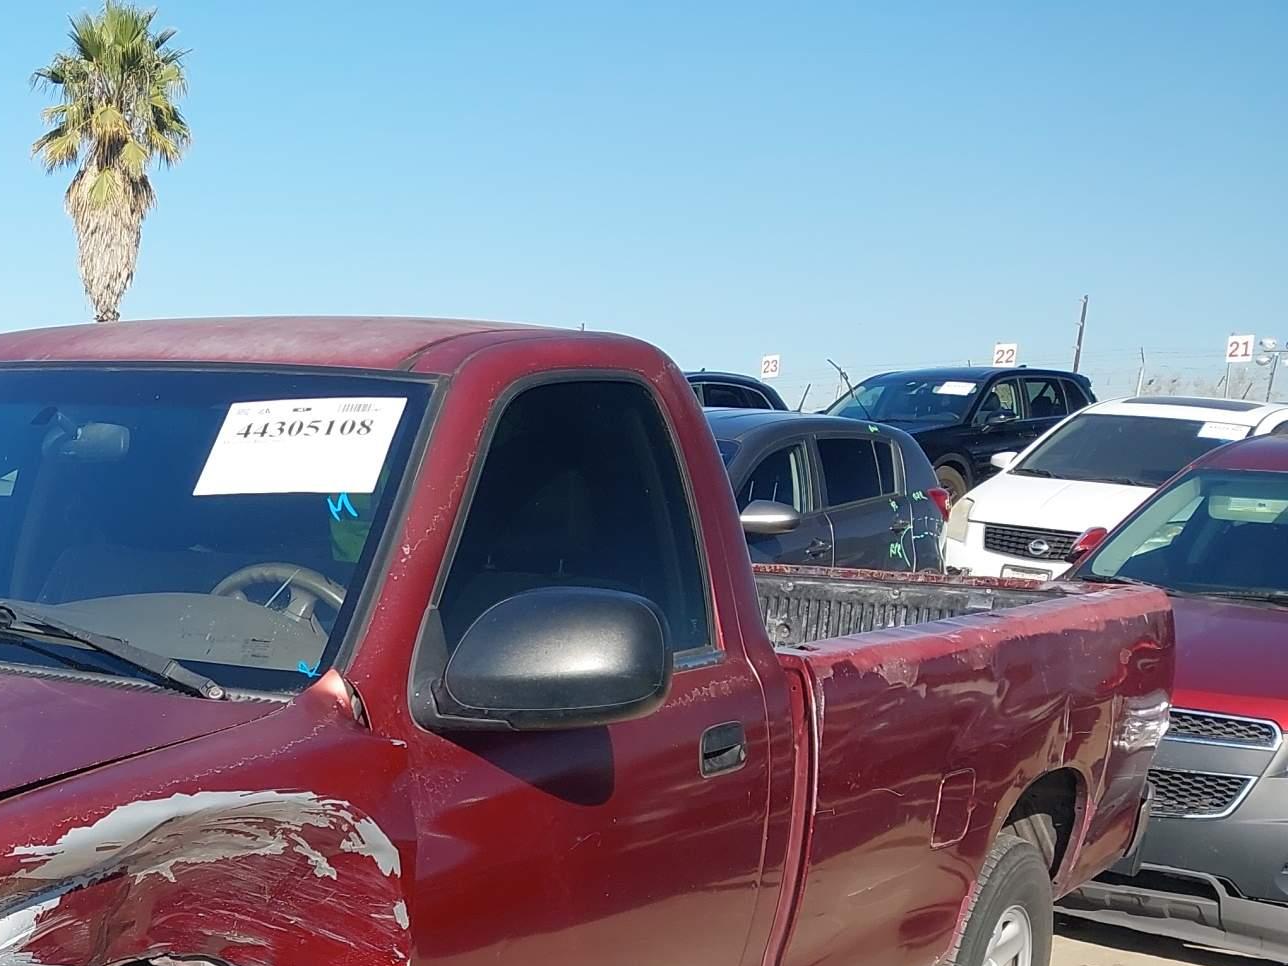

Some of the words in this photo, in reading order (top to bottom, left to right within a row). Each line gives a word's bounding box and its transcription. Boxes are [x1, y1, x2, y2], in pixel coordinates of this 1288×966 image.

[995, 349, 1015, 363] 22
[1229, 340, 1250, 357] 21
[763, 359, 778, 373] 23
[236, 419, 374, 438] 44305108
